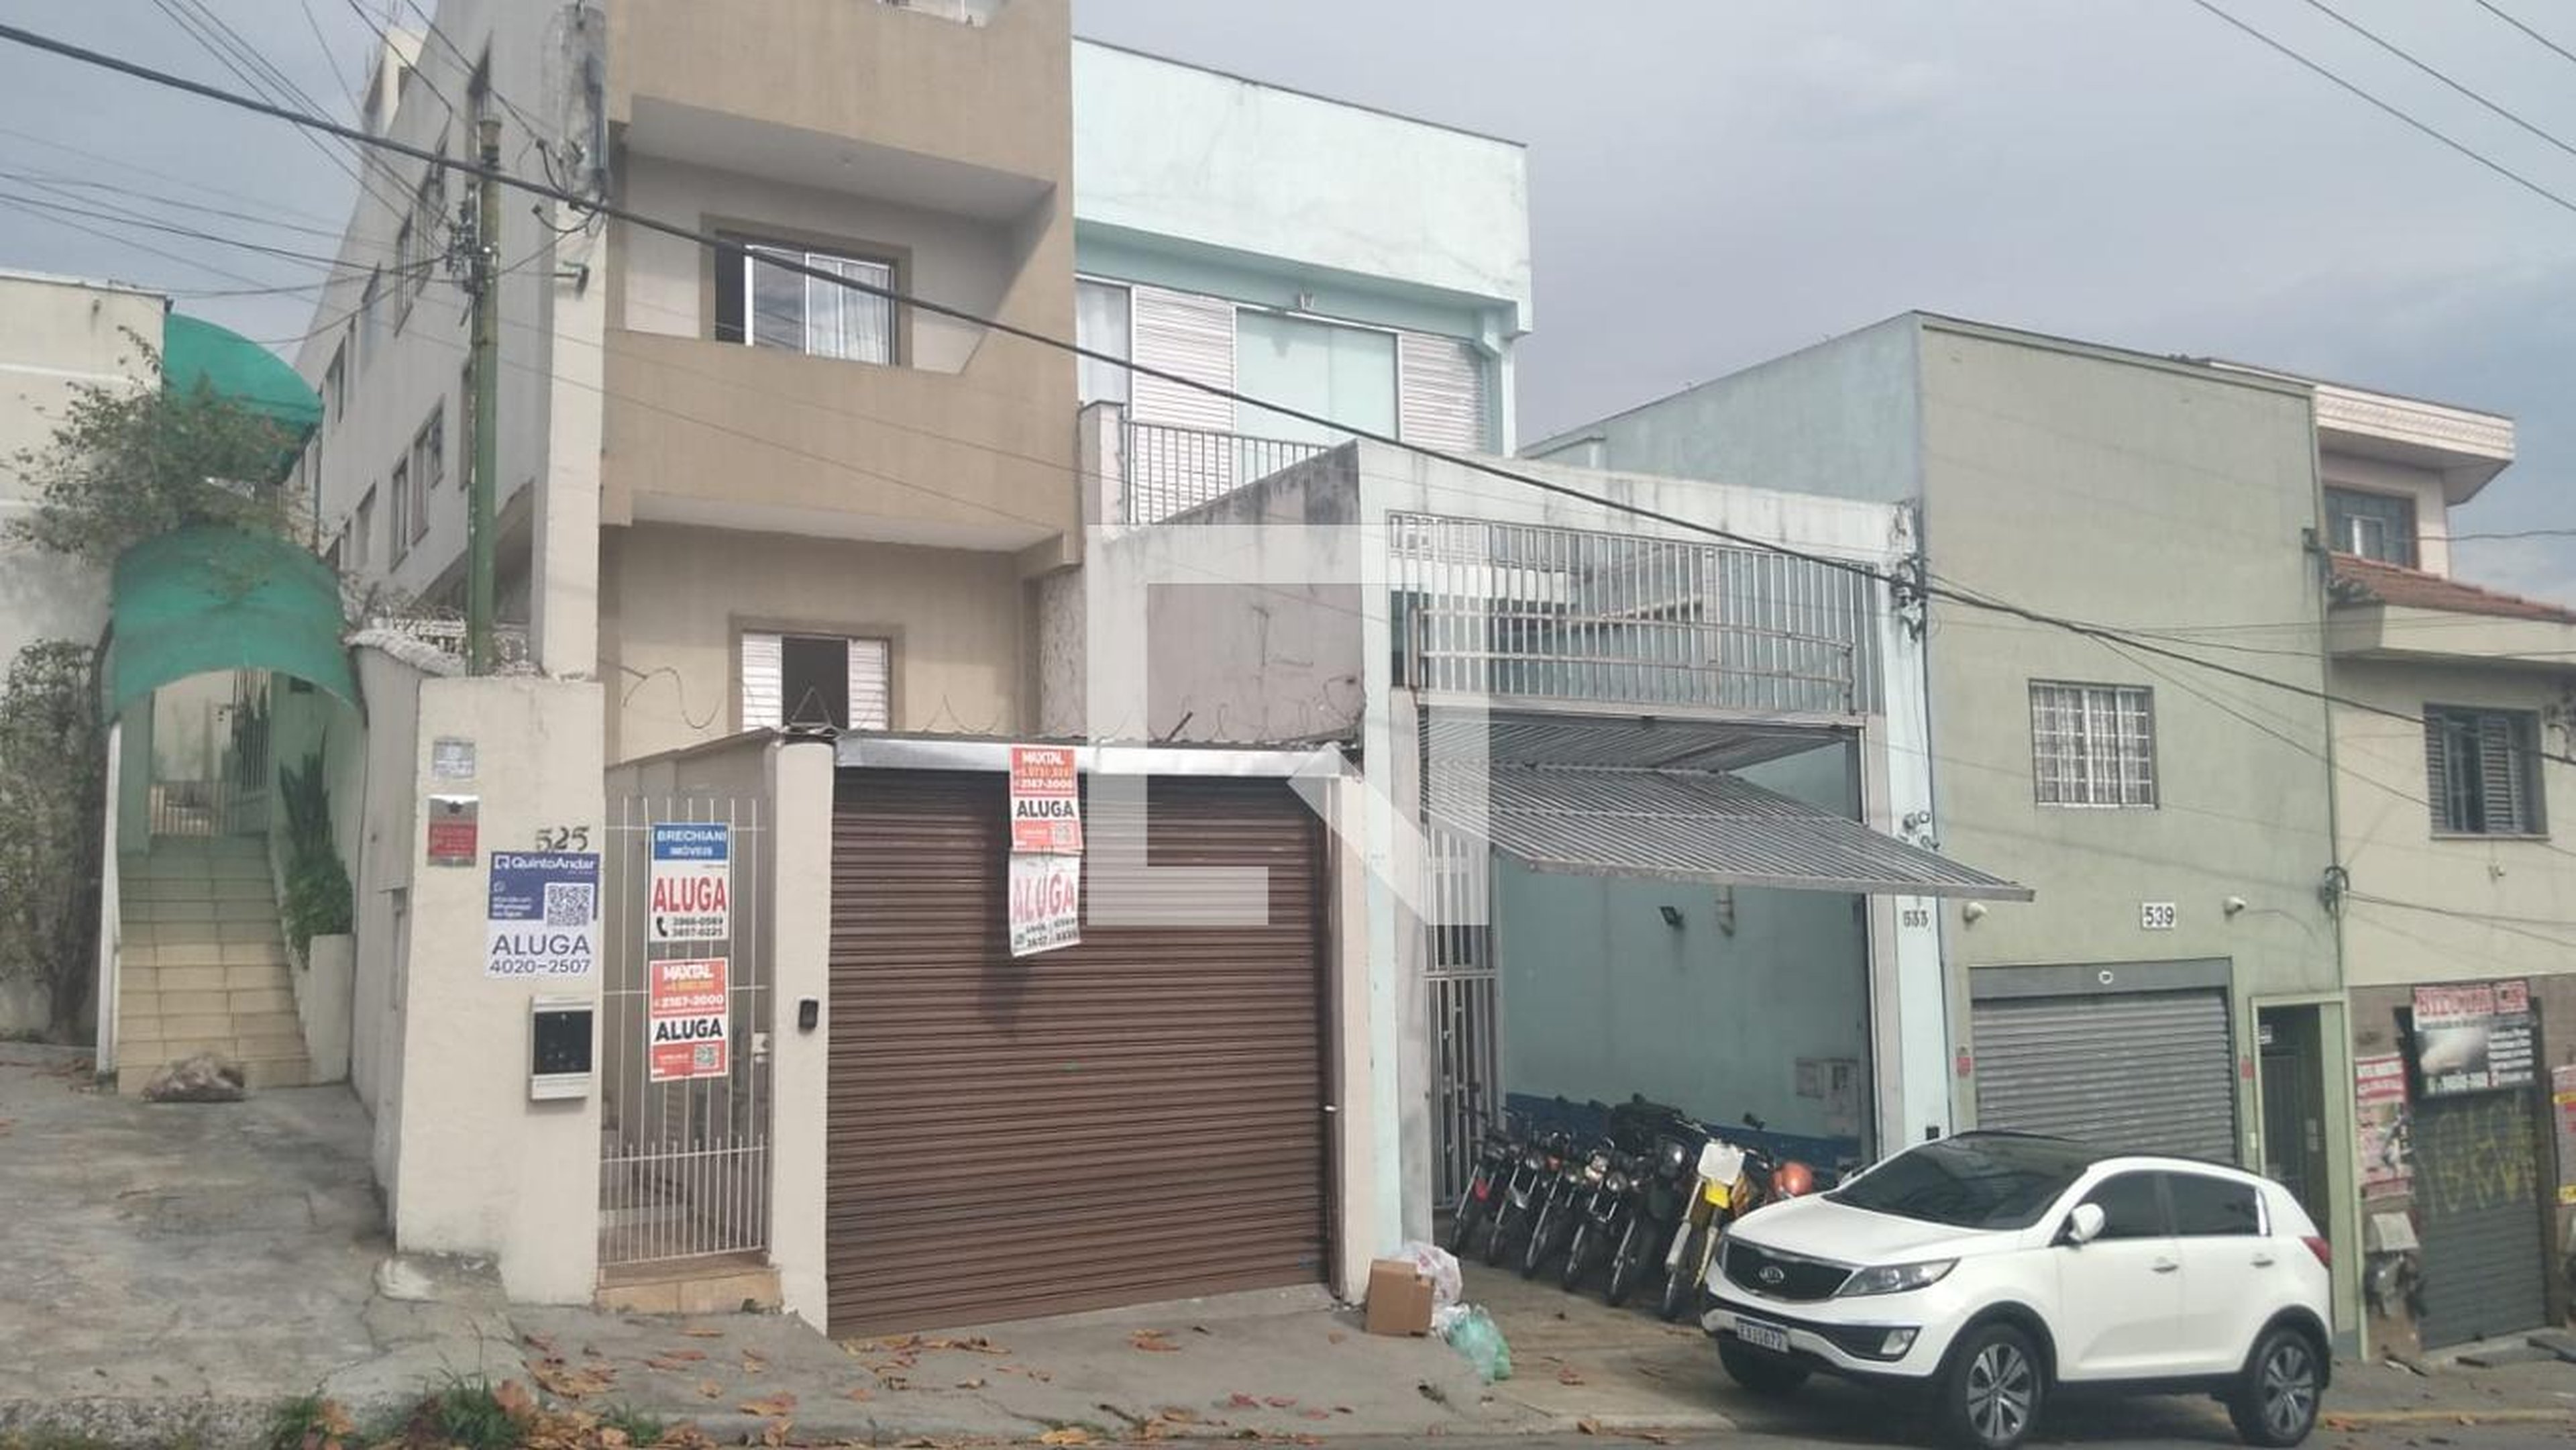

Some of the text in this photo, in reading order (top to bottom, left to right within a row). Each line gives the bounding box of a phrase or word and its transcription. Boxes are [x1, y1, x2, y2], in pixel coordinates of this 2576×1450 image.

[1016, 800, 1075, 818] ALUGA
[535, 826, 589, 851] 525
[511, 856, 594, 870] QuintoAndar
[653, 877, 727, 912] ALUGA
[1012, 874, 1074, 922] ALUGA
[2145, 906, 2174, 925] 539
[492, 934, 591, 955] ALUGA
[490, 960, 591, 973] 4020-2507
[655, 1019, 723, 1041] ALUGA
